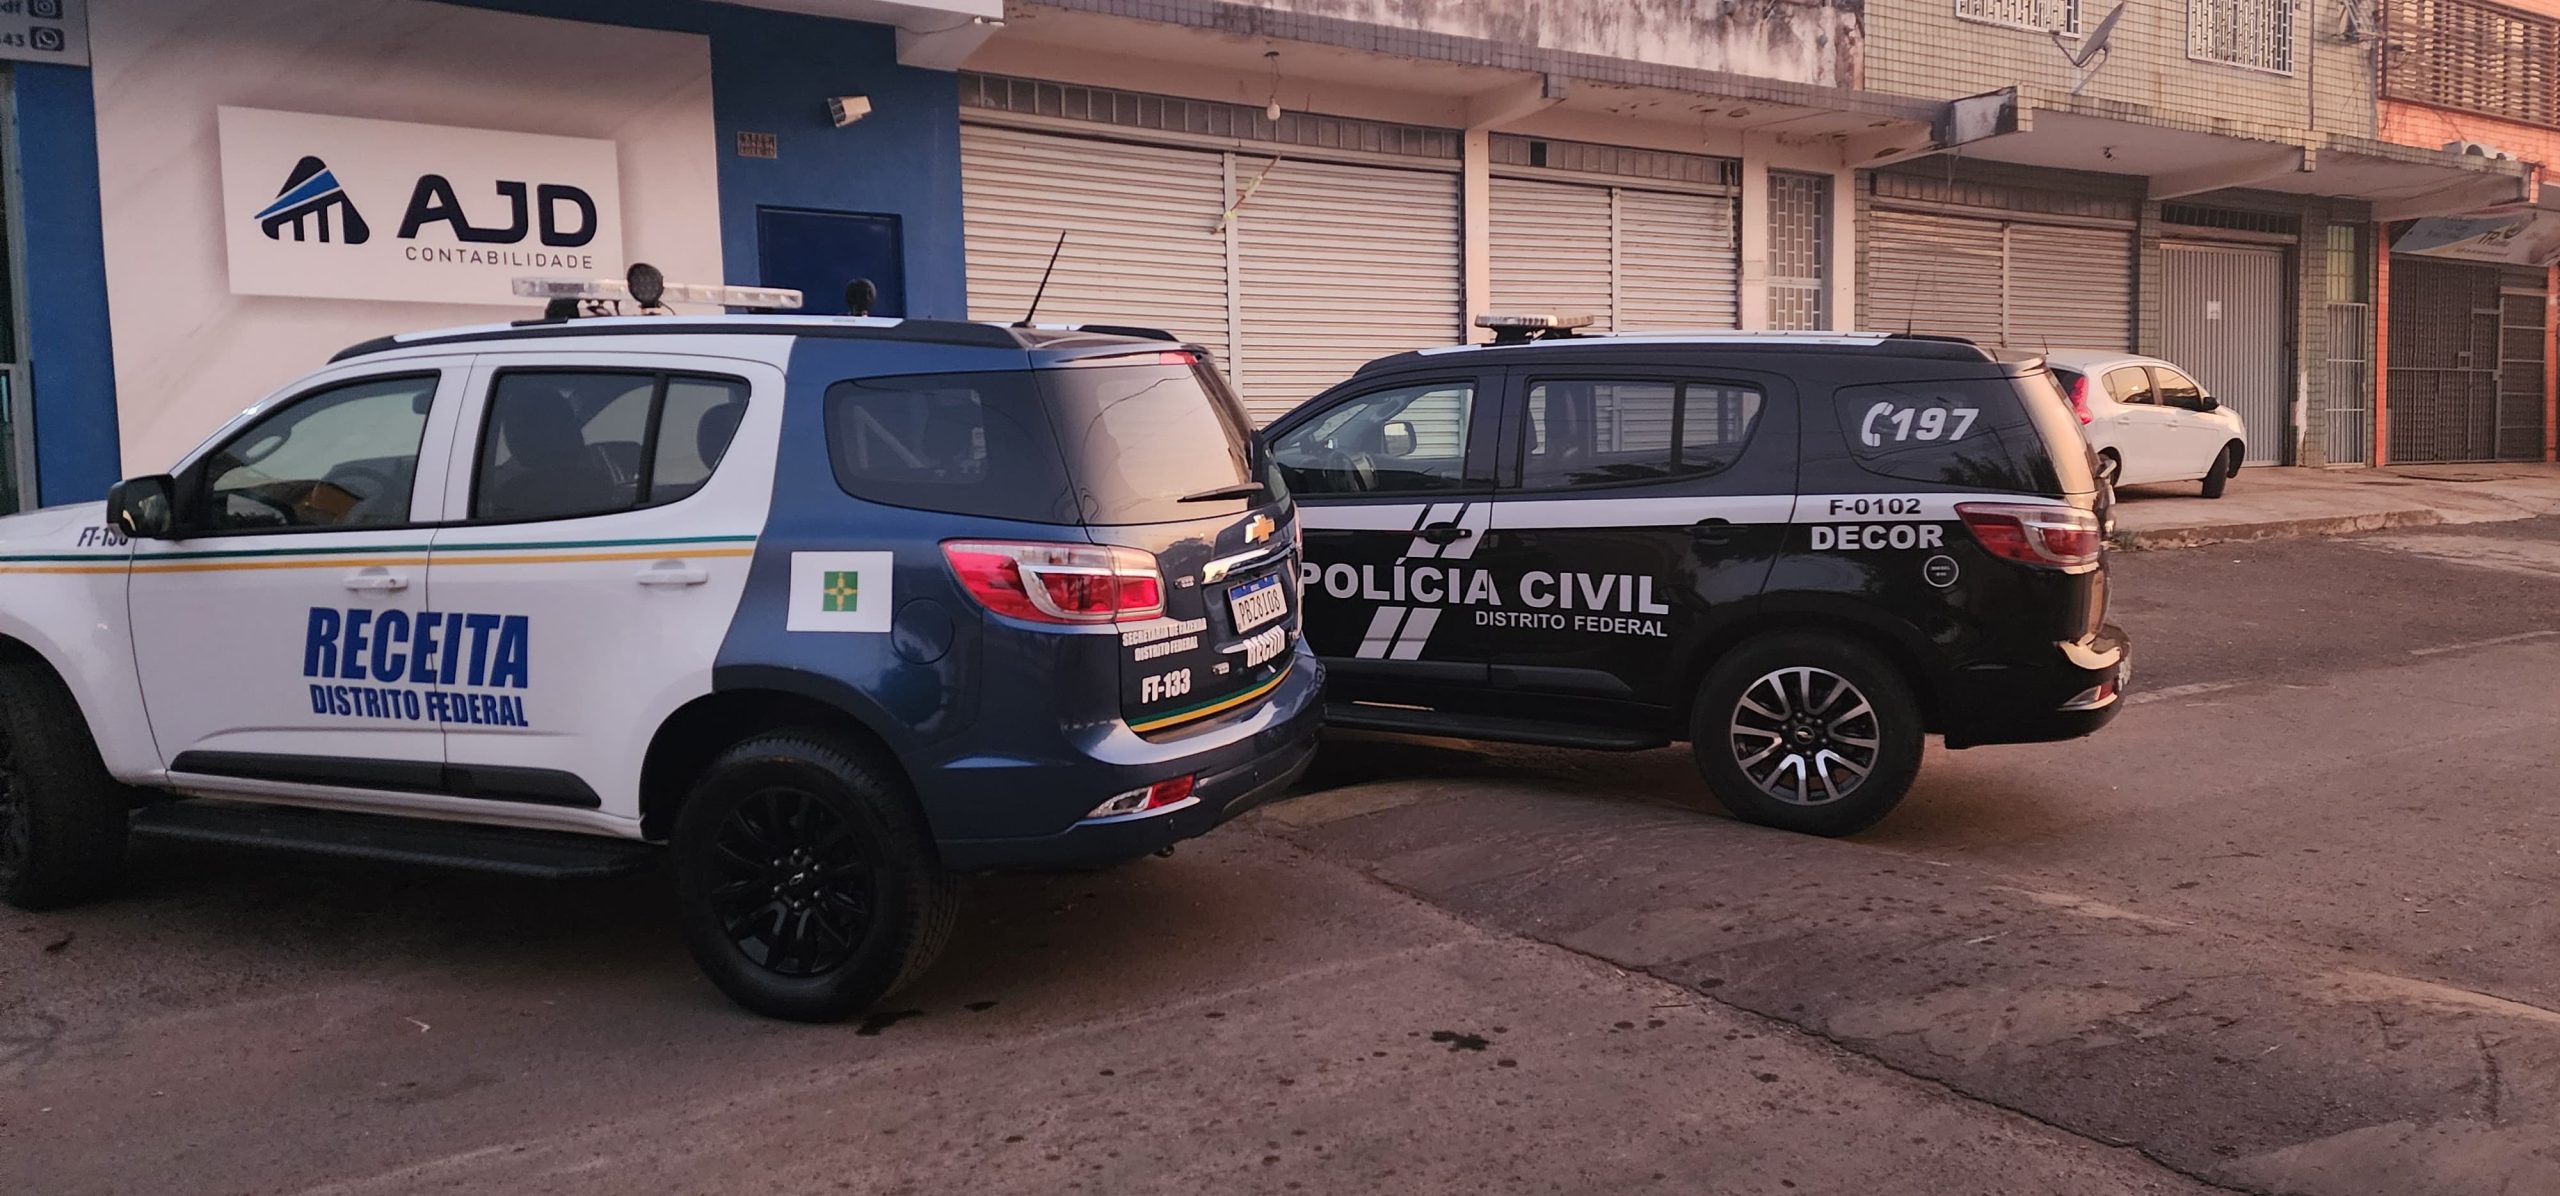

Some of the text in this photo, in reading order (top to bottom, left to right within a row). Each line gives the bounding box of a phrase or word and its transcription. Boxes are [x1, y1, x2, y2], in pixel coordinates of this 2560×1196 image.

[397, 174, 597, 247] AJD
[405, 247, 592, 269] CONTABILIDADE
[1891, 407, 1979, 441] 197
[1829, 498, 1921, 515] F-0102
[1811, 524, 1944, 550] DECOR
[1300, 557, 1669, 615] POLÍCIA CIVIL
[1475, 611, 1668, 637] DISTRITO FEDERAL
[303, 607, 528, 688] RECEITA
[1134, 635, 1198, 662] DISTRITO FEDERAL
[1141, 667, 1191, 704] FT-133
[309, 684, 529, 727] DISTRITO FEDERAL
